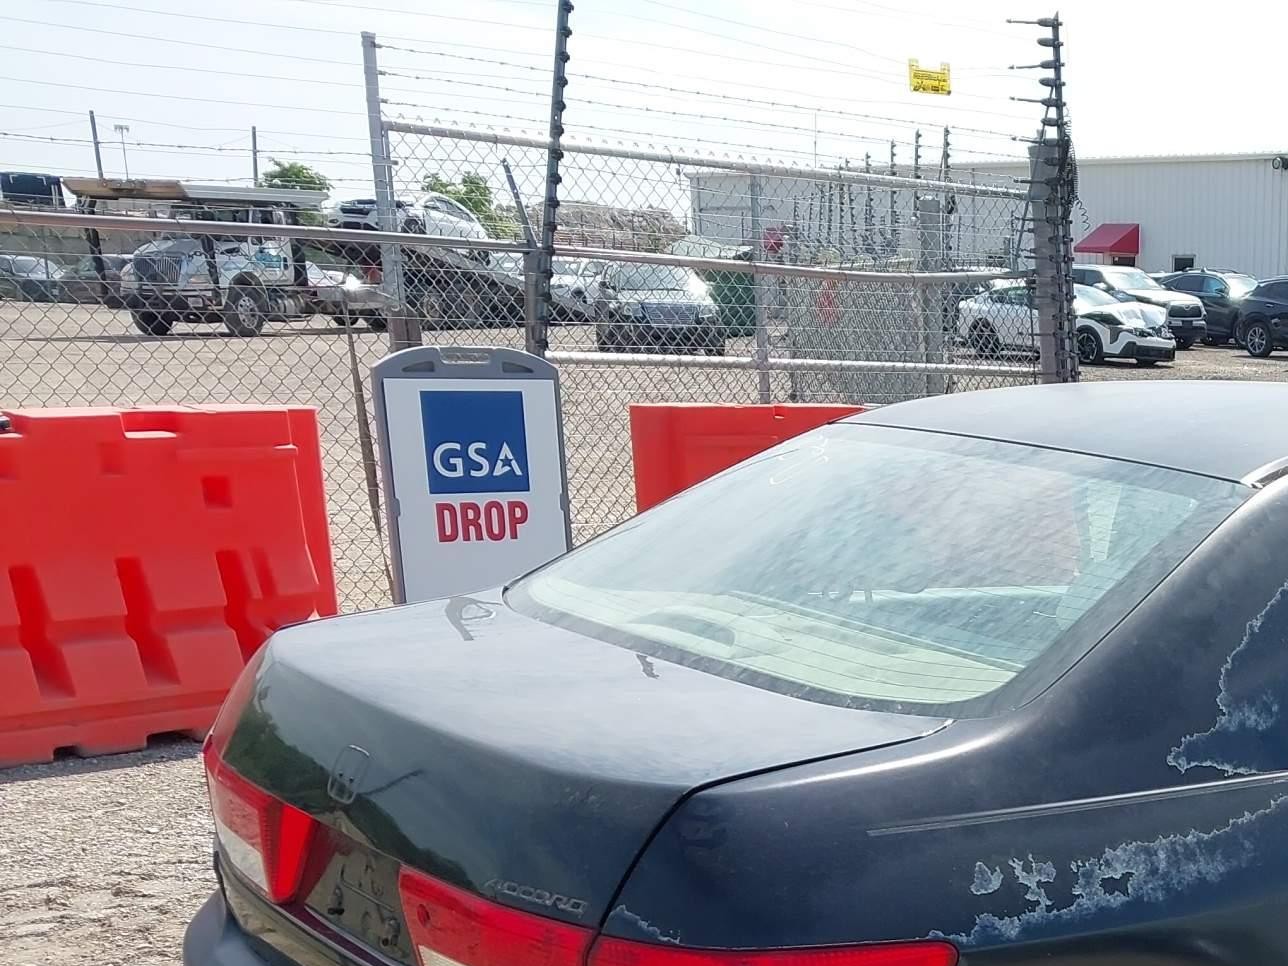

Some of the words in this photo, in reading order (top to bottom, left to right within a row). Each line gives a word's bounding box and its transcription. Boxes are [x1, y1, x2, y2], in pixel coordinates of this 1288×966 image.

[433, 441, 523, 478] GSA
[435, 500, 529, 542] DROP
[484, 878, 589, 914] ACCORD
